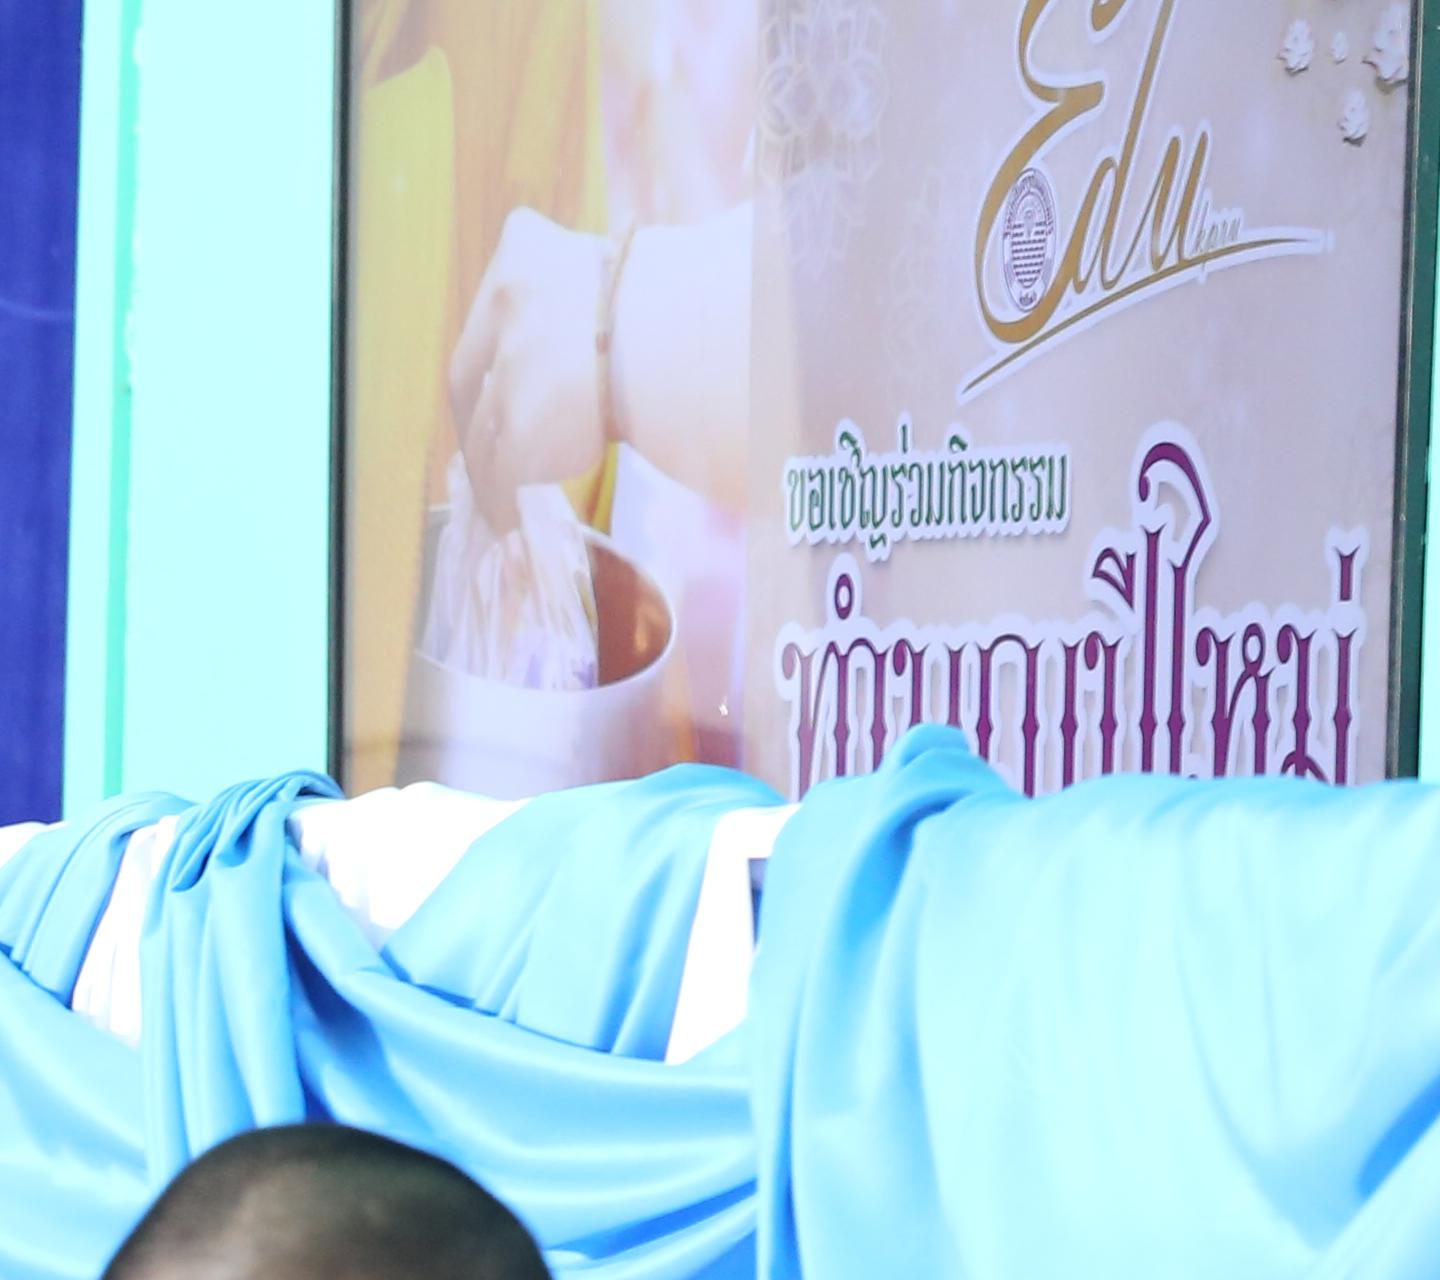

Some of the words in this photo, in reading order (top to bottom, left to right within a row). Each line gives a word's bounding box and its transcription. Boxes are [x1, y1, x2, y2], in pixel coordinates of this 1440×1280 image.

[977, 0, 1210, 345] Edu
[781, 441, 1362, 800] ทำบญปีใหม่
[787, 424, 1069, 550] ขอเชิญร่วมกิจกรรม
